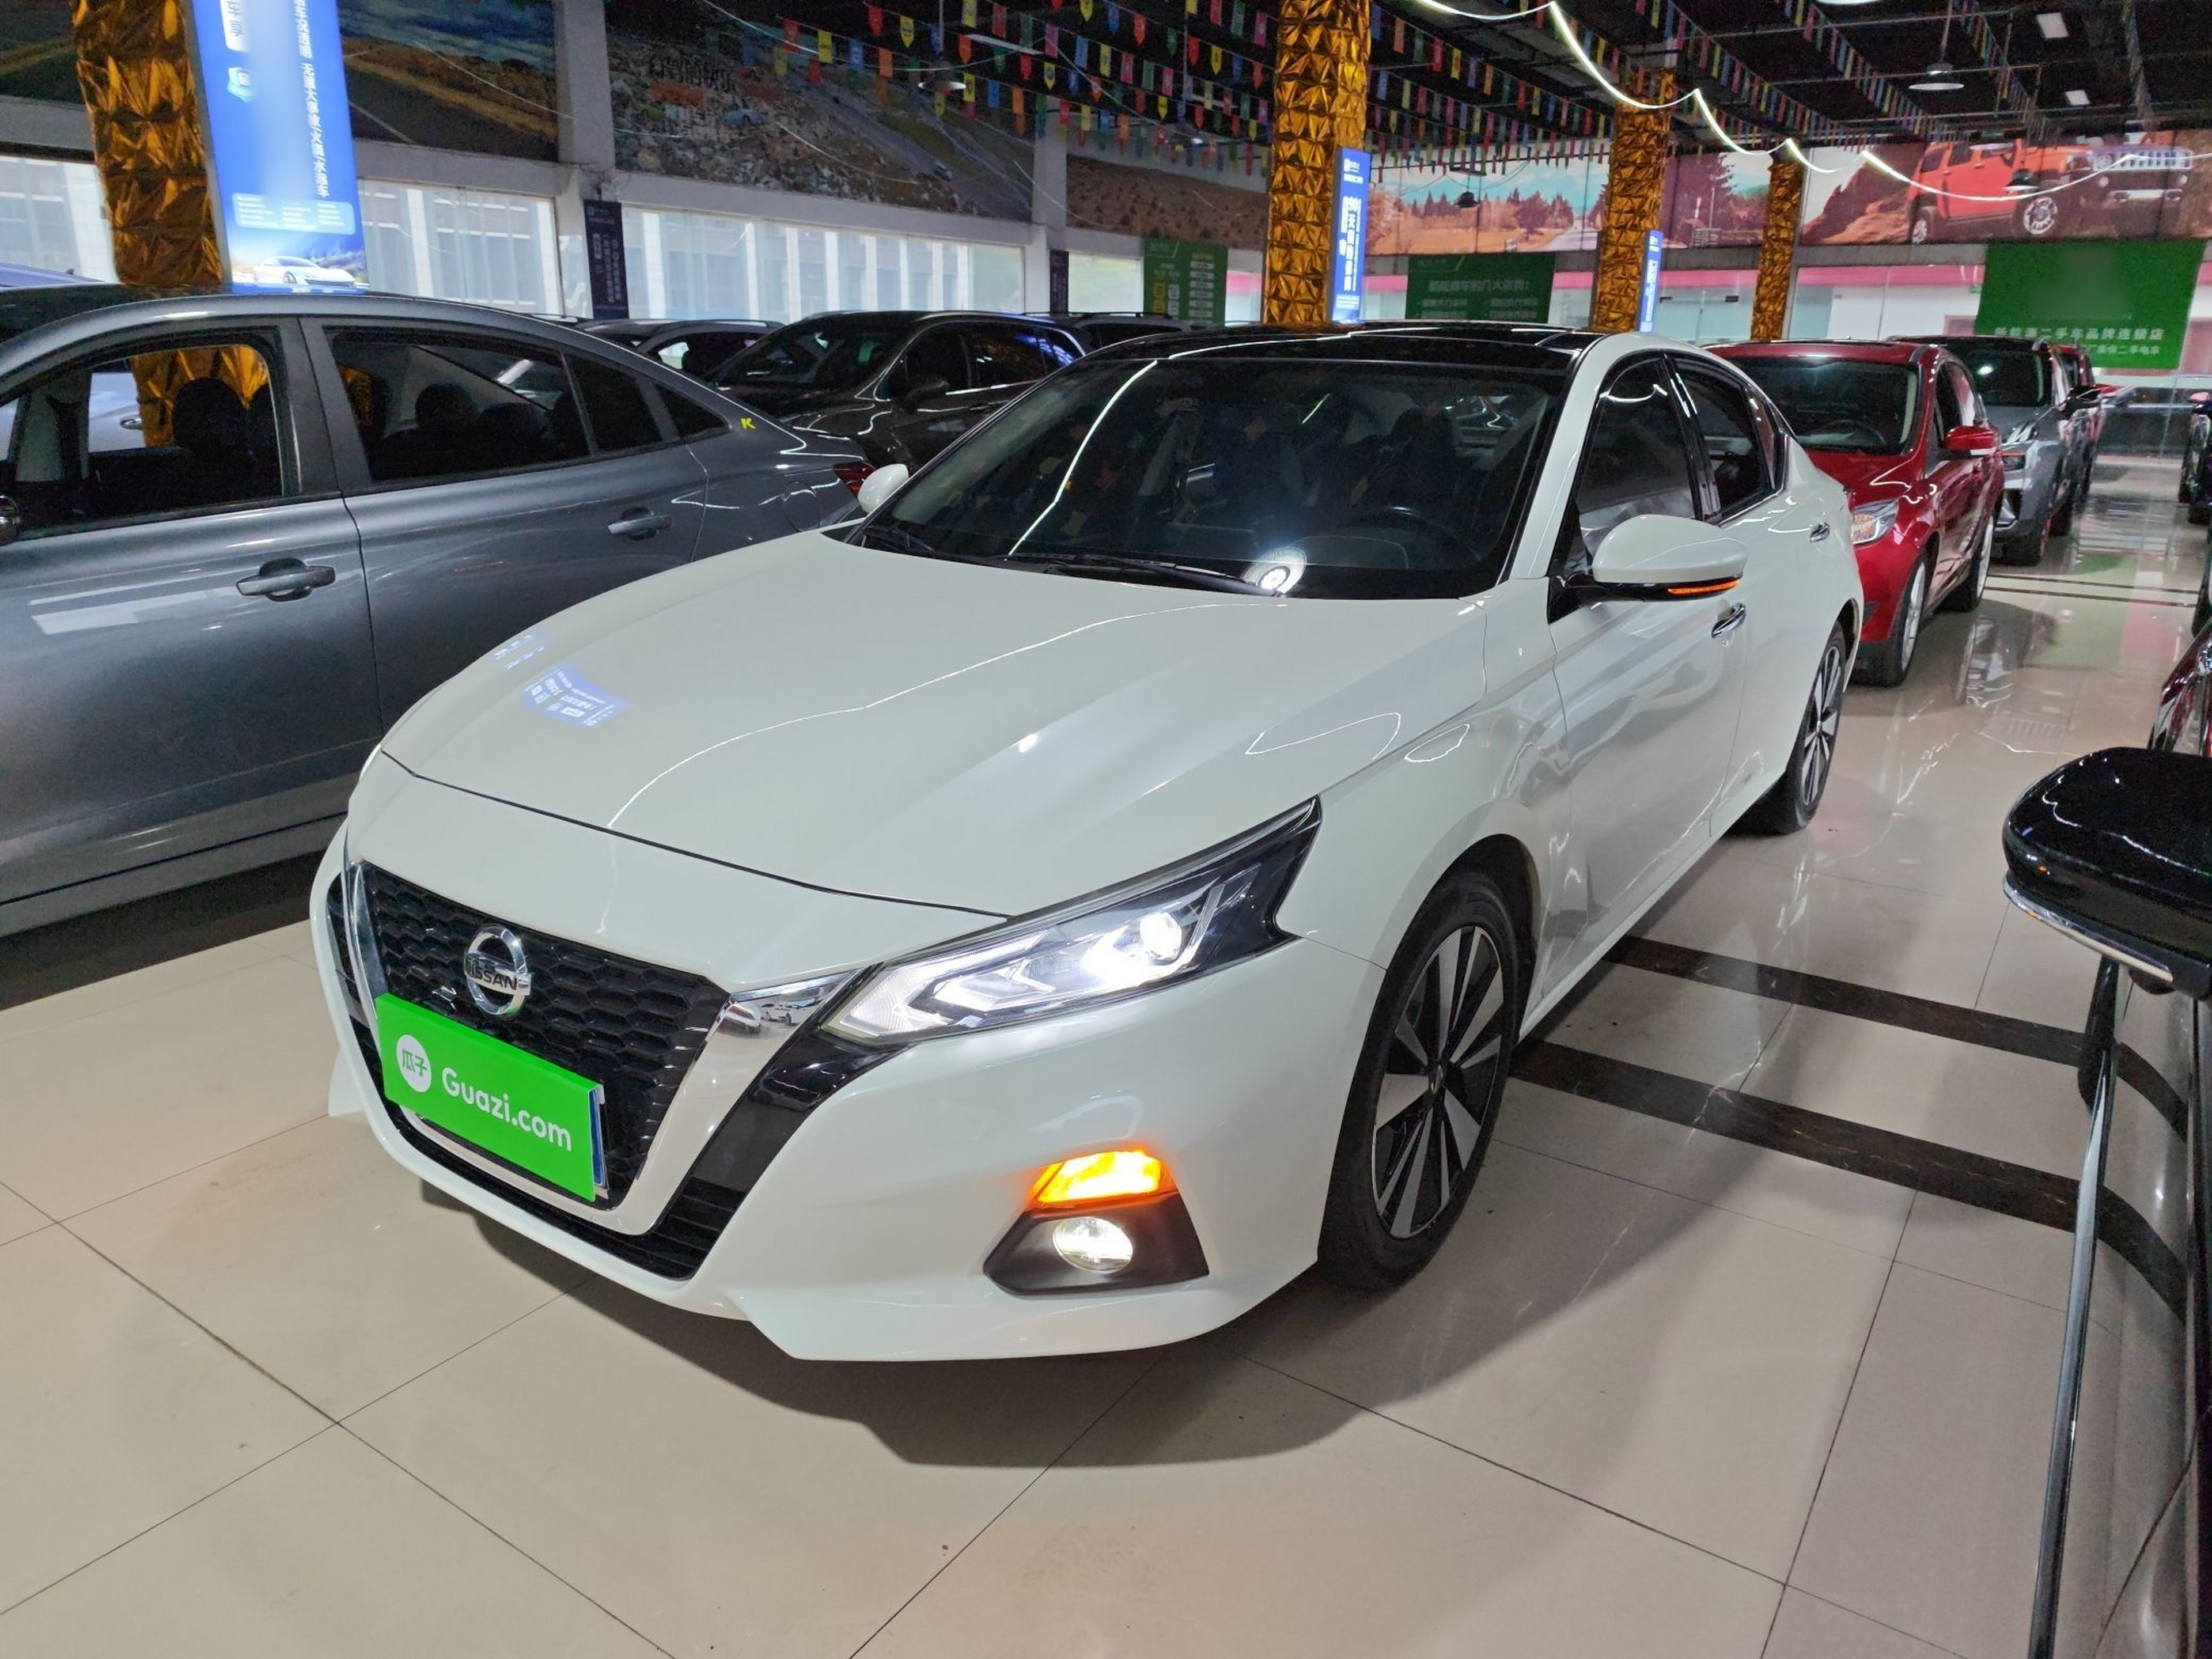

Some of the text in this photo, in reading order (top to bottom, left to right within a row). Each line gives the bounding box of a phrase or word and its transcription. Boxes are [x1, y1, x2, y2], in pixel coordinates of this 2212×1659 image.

[466, 957, 517, 990] ISSAN
[403, 1048, 427, 1077] 瓜子
[442, 1067, 571, 1152] Guazi.com
